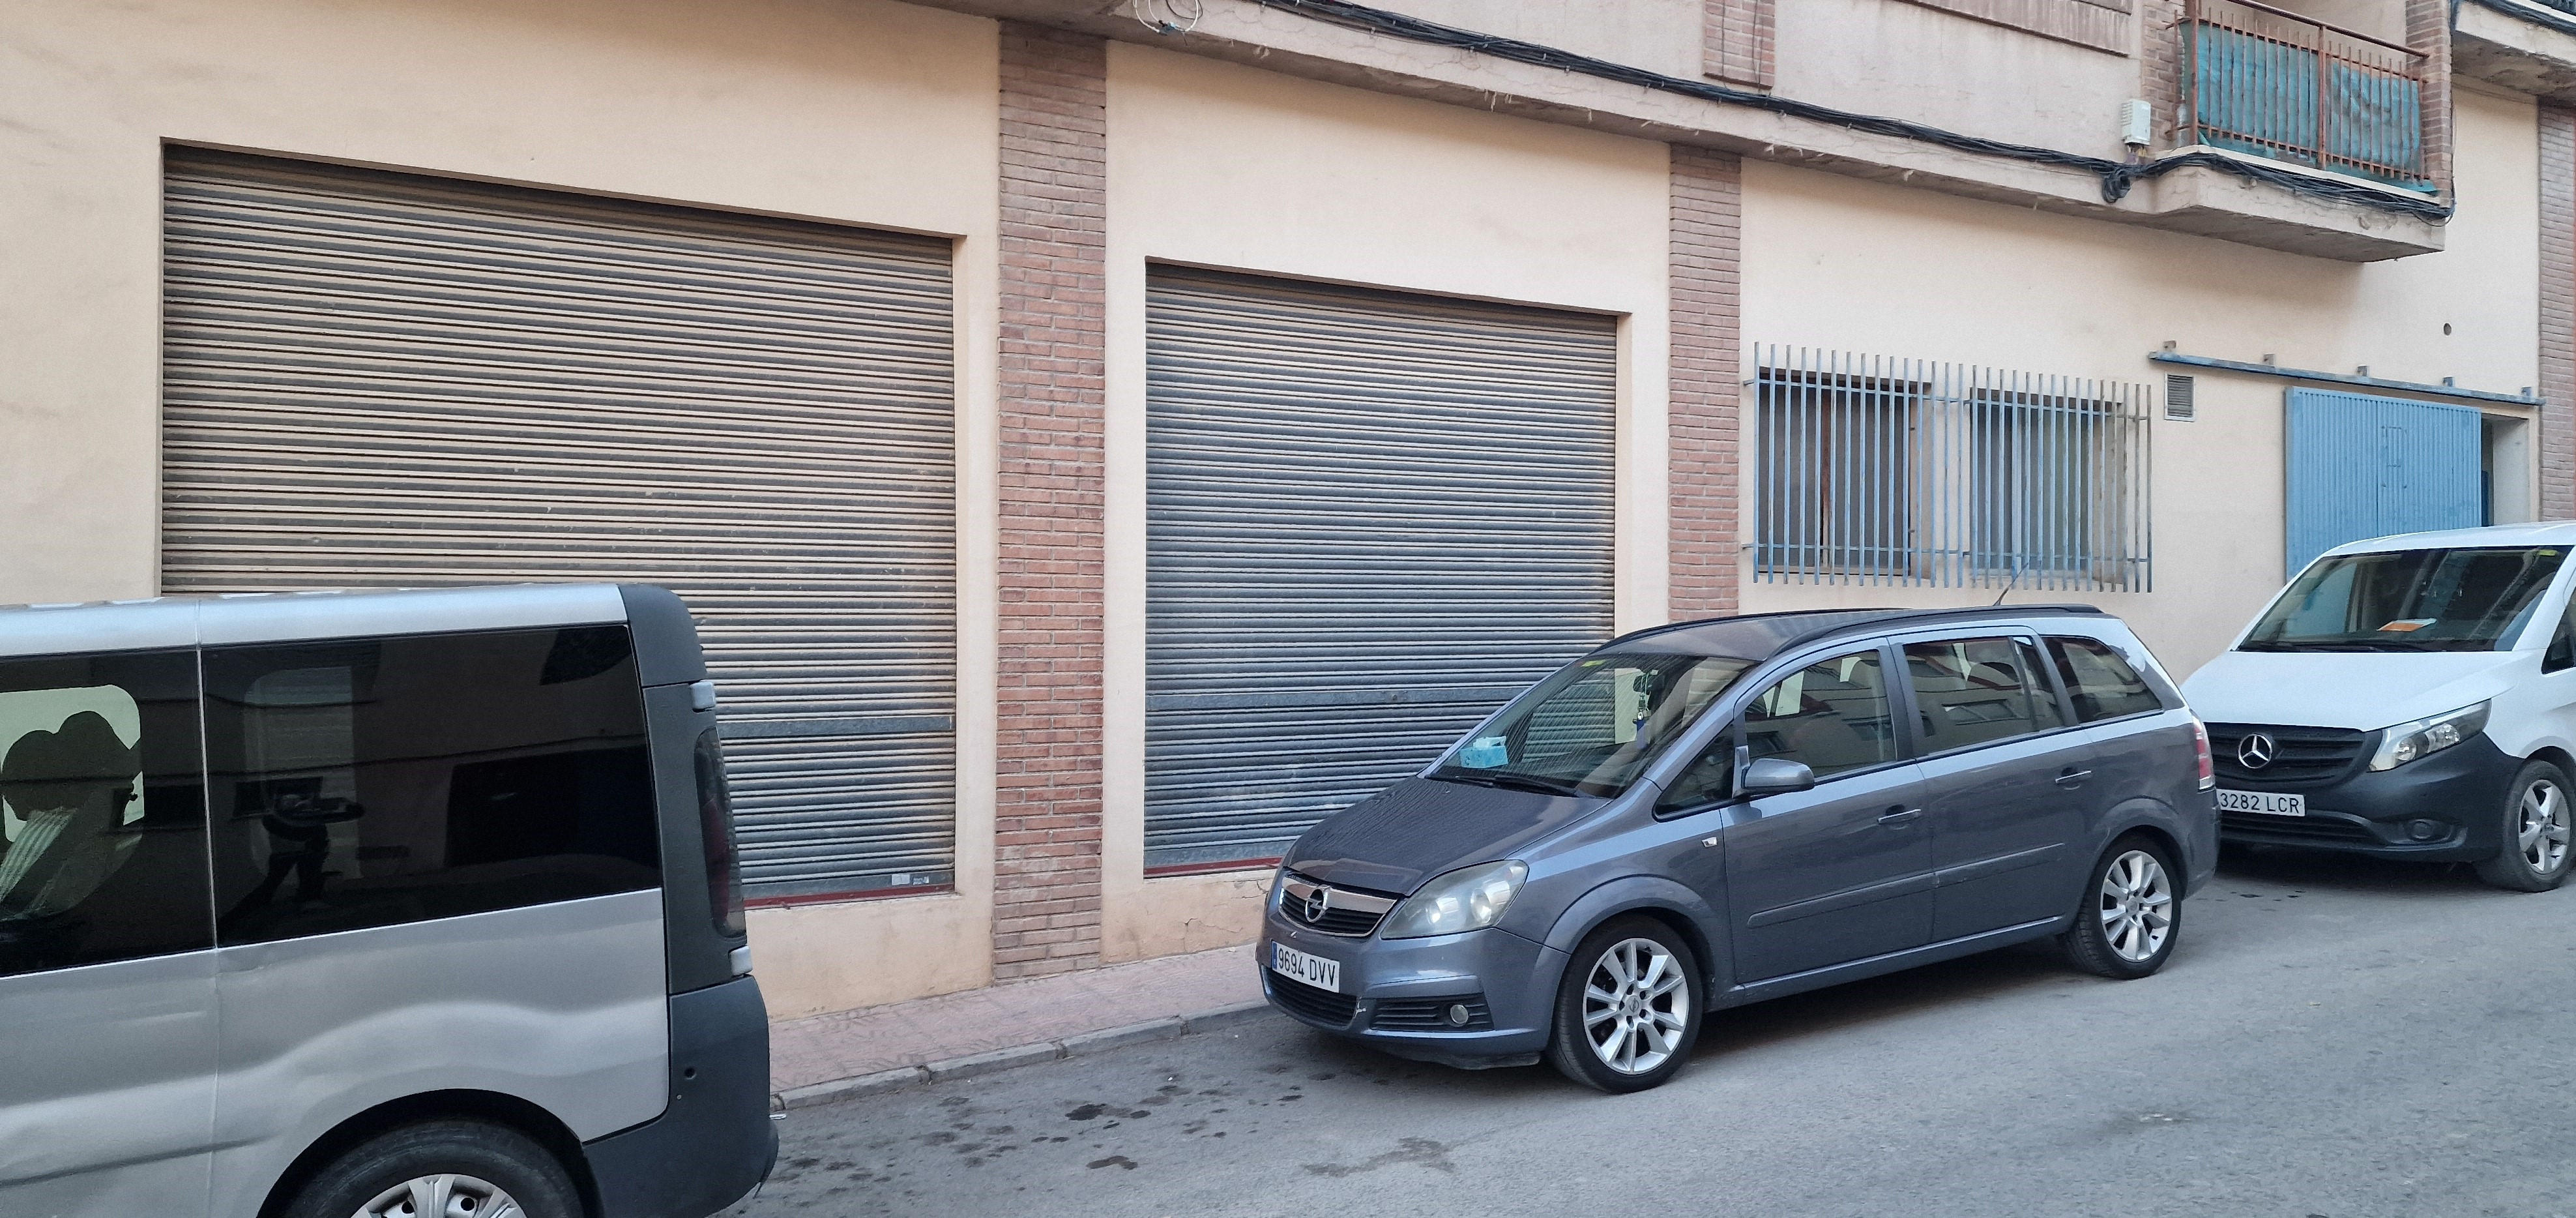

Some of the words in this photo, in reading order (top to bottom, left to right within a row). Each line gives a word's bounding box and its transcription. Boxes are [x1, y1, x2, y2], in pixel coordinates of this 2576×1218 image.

[2220, 792, 2261, 811] 3282
[2266, 796, 2300, 814] LCR
[1278, 947, 1305, 978] 9694
[1310, 958, 1336, 987] DVV
